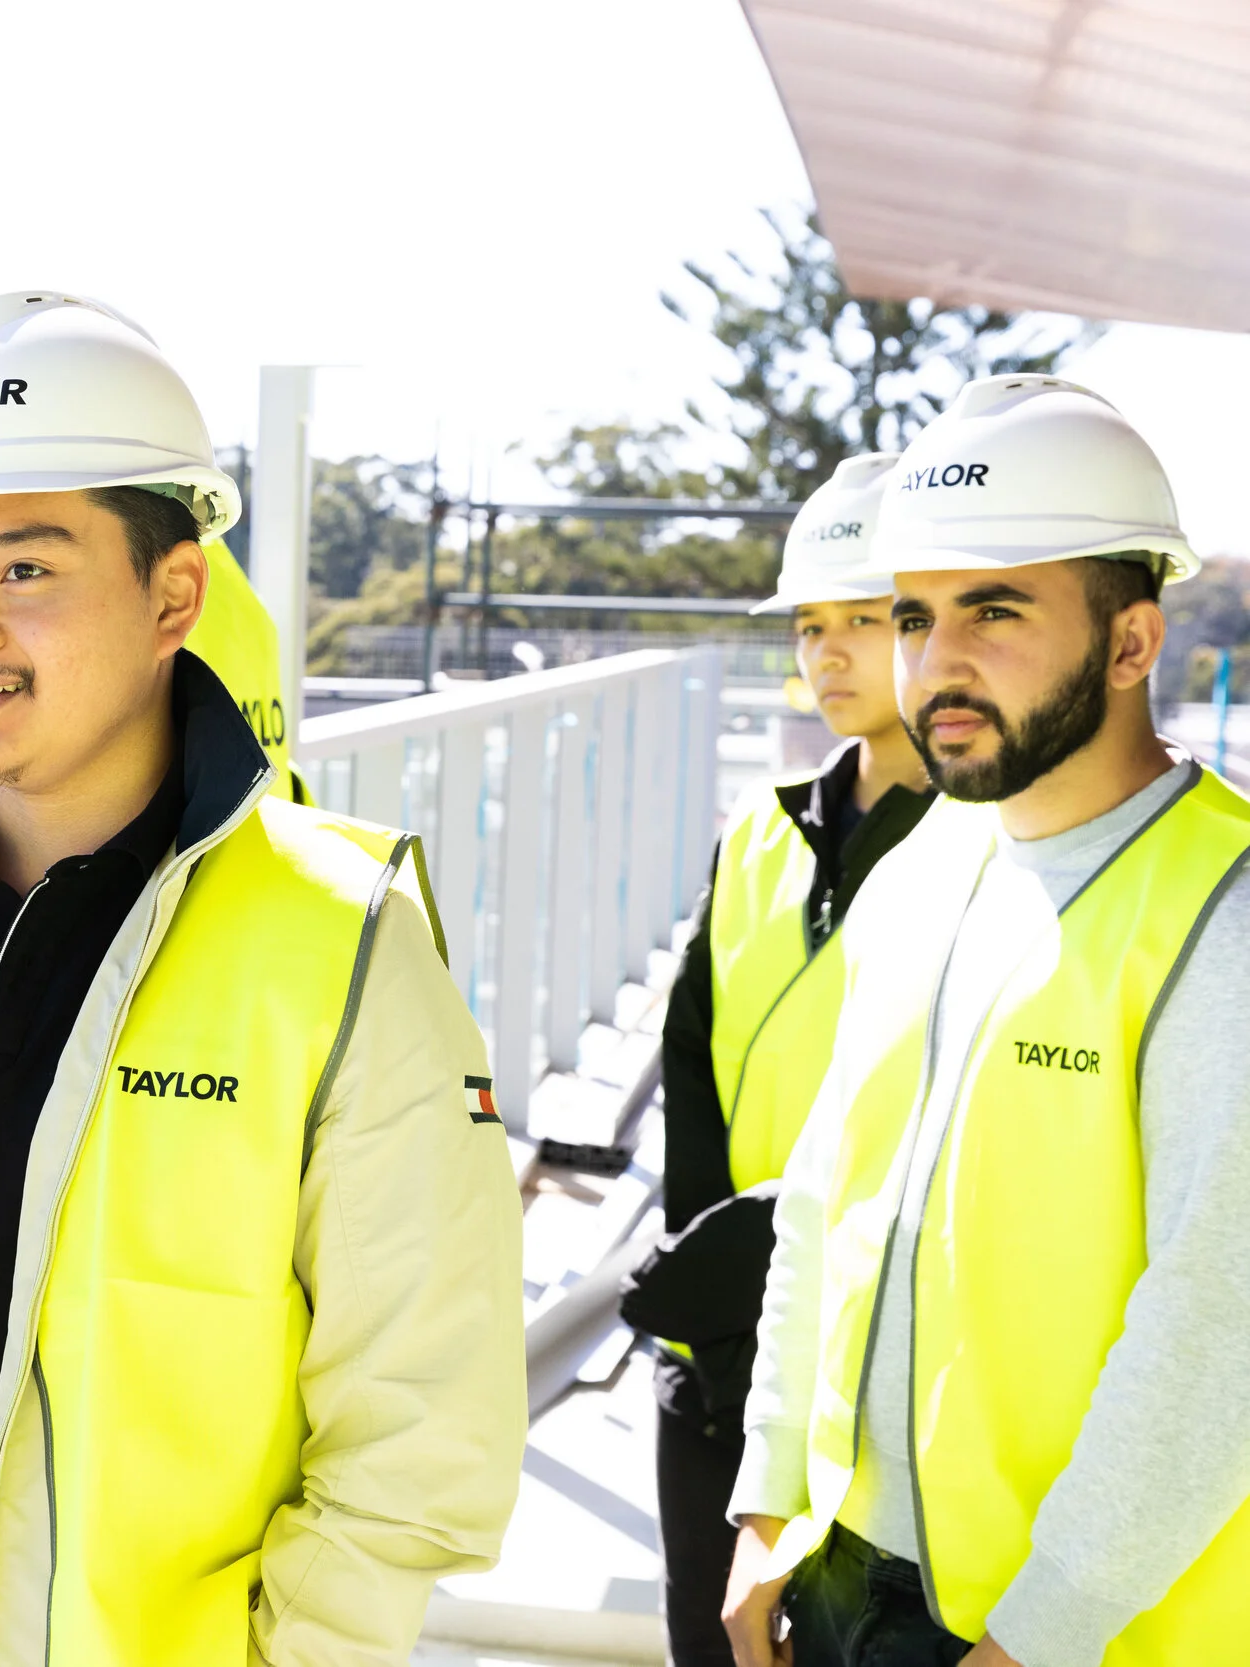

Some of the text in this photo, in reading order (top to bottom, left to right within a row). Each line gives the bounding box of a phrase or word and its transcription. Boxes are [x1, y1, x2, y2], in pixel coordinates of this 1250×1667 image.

[900, 463, 990, 493] AYLOR
[1014, 1041, 1100, 1074] TAYLOR
[117, 1065, 239, 1103] TAYLOR
